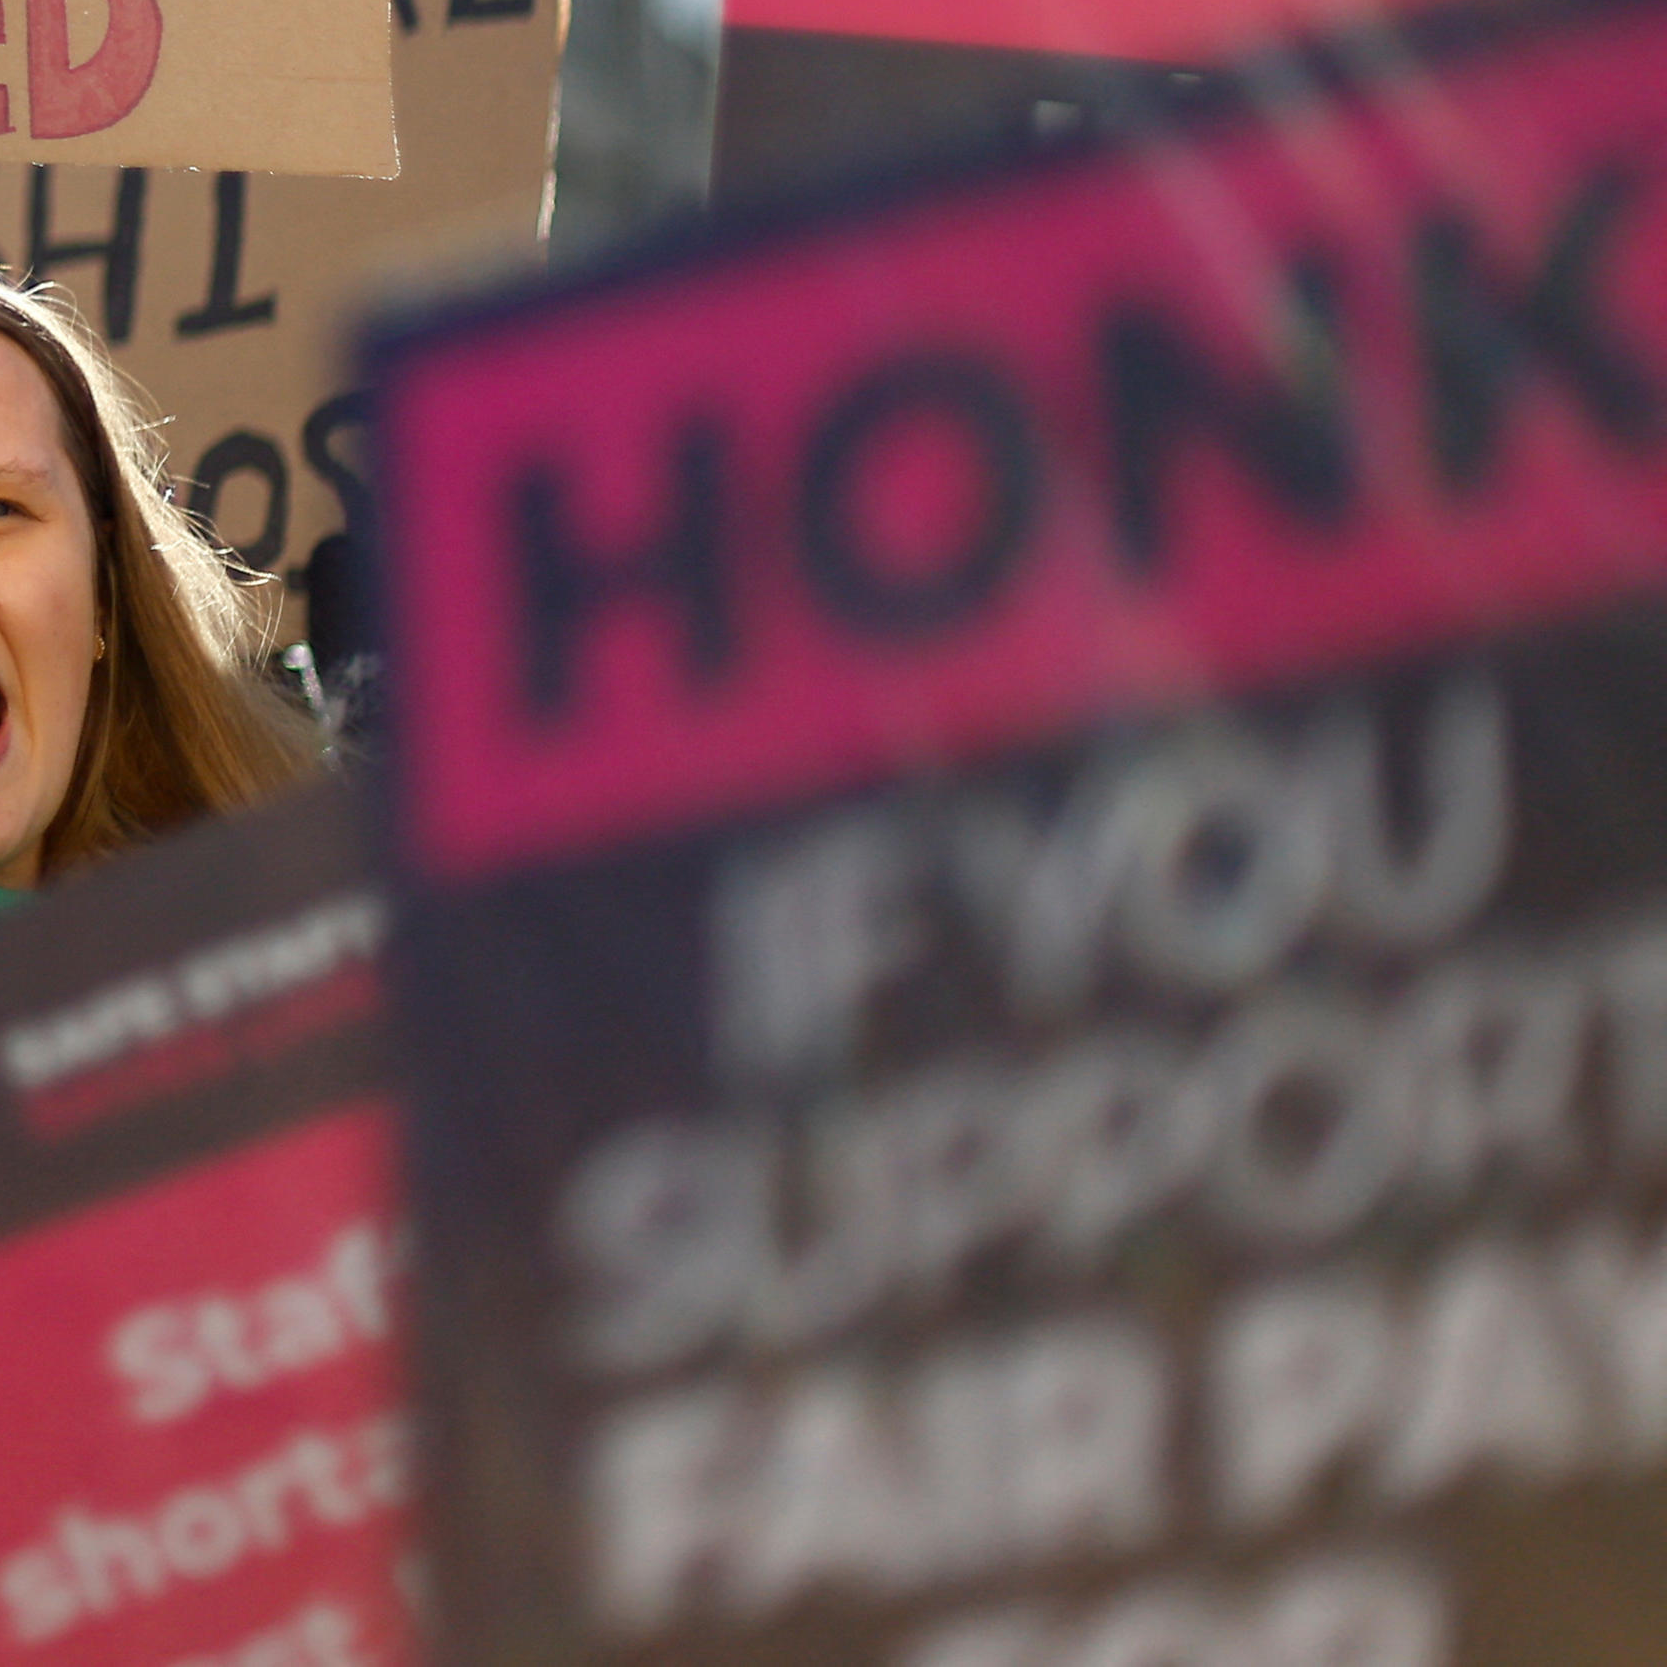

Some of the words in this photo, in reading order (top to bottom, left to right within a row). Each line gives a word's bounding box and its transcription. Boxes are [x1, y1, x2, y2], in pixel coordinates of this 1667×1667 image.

[502, 154, 1667, 726] HONK
[947, 686, 1512, 1014] YOU
[107, 1219, 395, 1428] Staf
